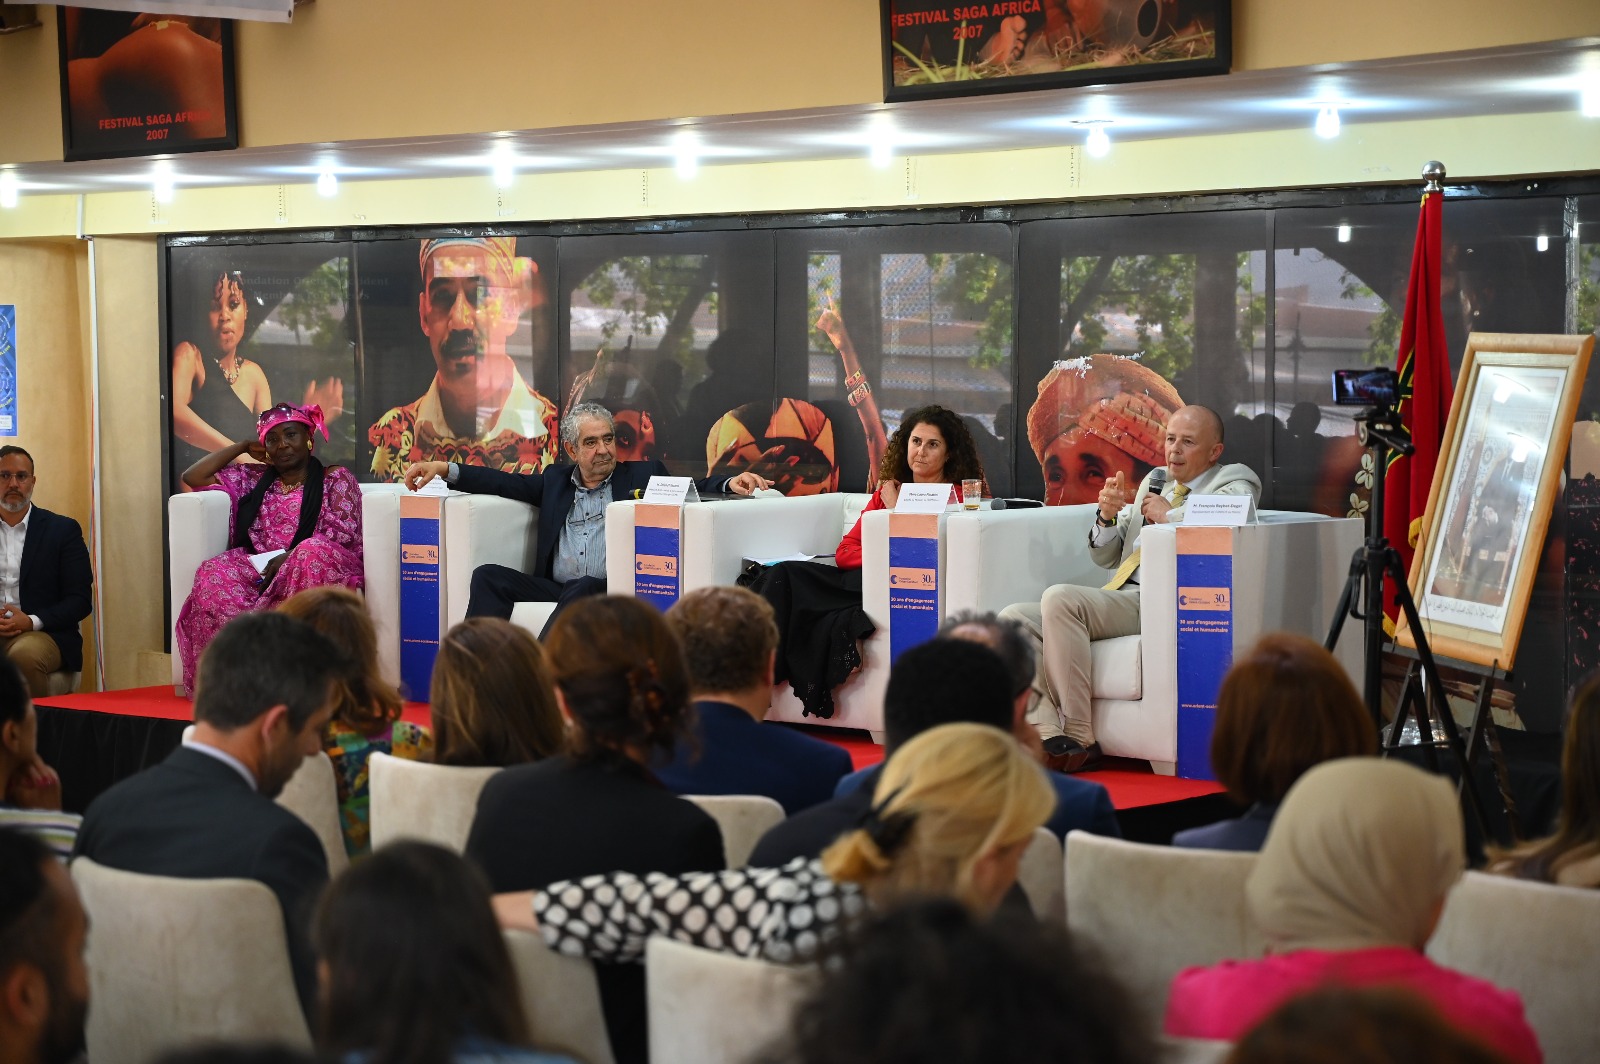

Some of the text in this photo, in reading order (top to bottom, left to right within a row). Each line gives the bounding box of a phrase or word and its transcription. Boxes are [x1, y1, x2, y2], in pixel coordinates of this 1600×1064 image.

[892, 0, 1041, 28] FESTIVAL SAGA AFRICA
[953, 25, 984, 40] 2007
[98, 111, 211, 129] FESTIVAL SAGA AFRI
[146, 129, 169, 141] 2007
[921, 573, 931, 584] 30
[1213, 593, 1225, 604] 30
